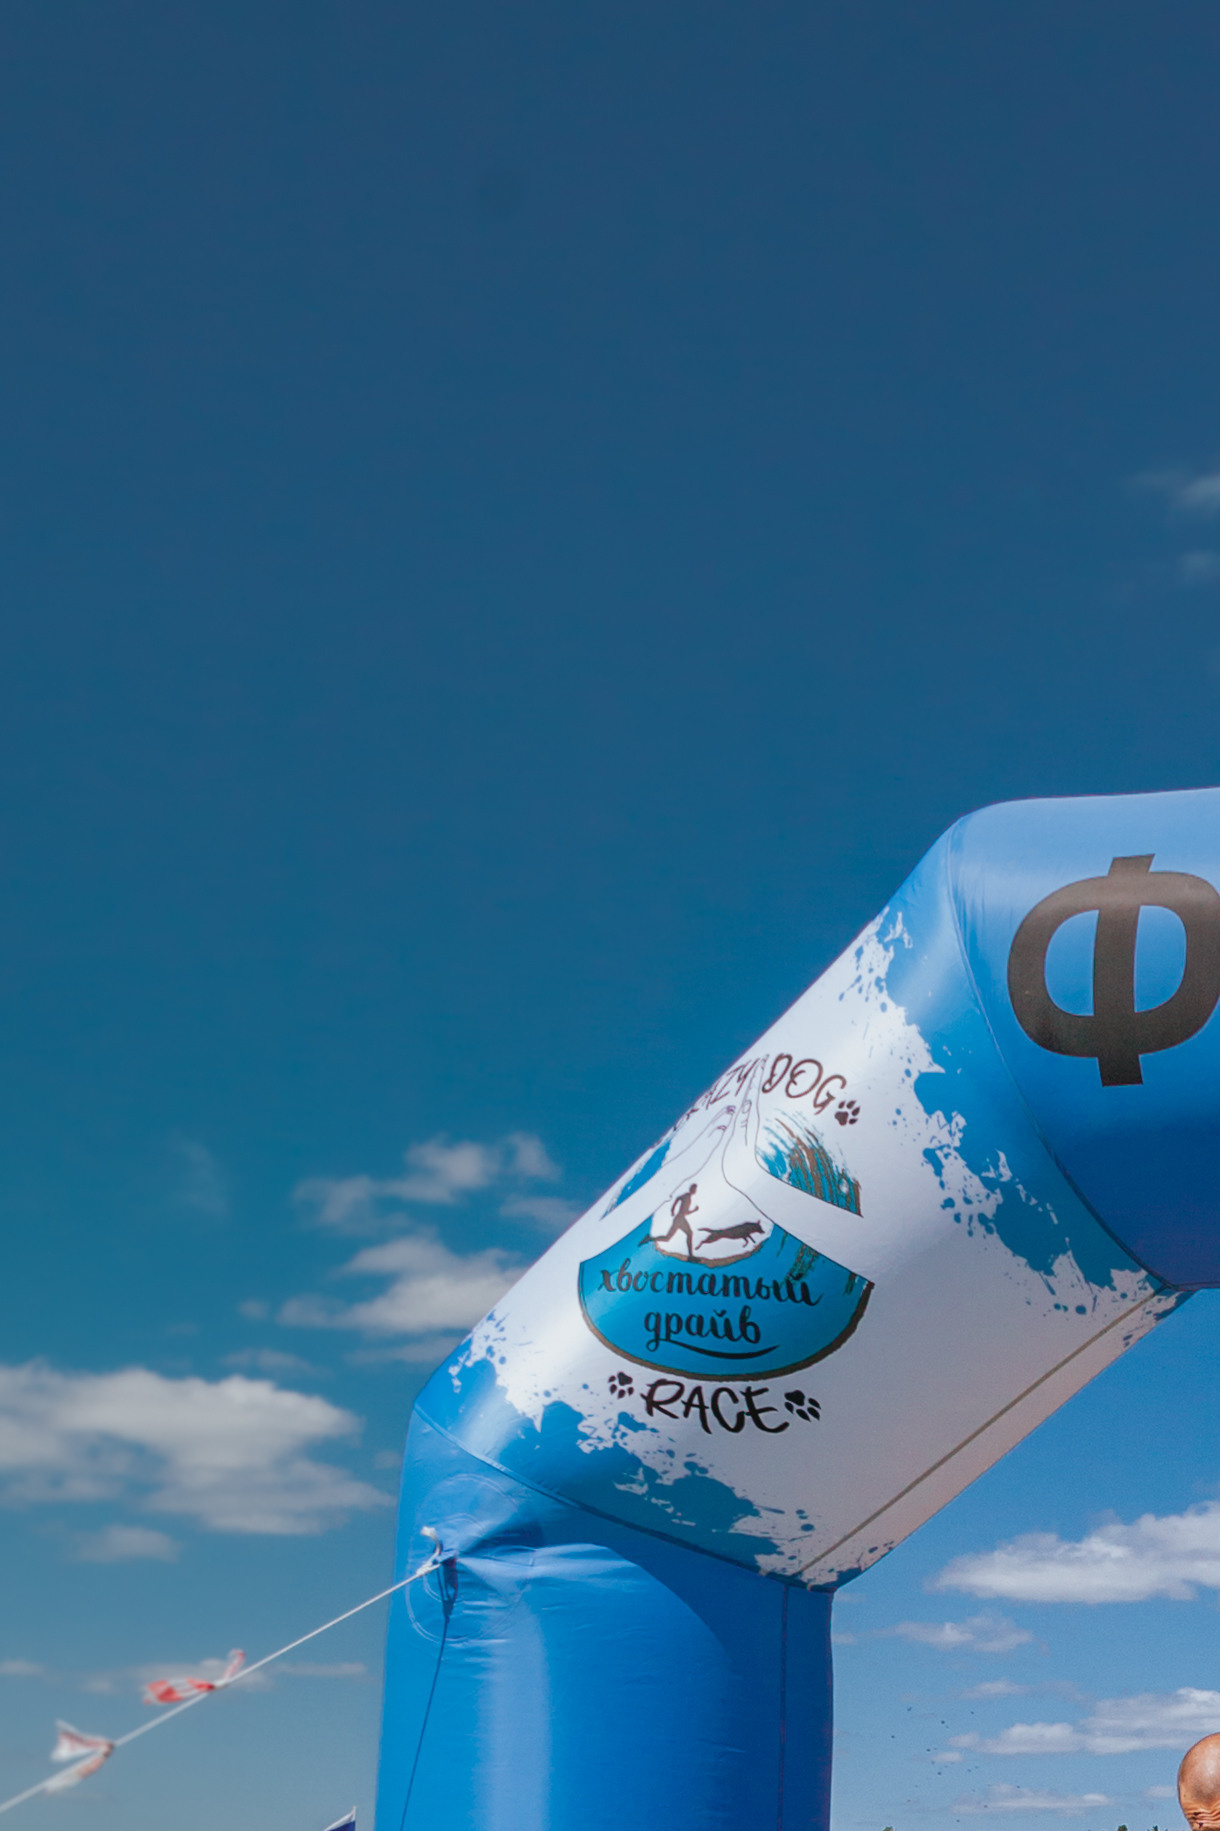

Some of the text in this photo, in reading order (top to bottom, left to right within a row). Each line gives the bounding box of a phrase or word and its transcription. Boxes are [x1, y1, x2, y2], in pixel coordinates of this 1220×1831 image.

[762, 1053, 847, 1115] DOG
[597, 1258, 824, 1306] хвостатый
[644, 1305, 764, 1353] драйв
[640, 1378, 790, 1434] RACE
